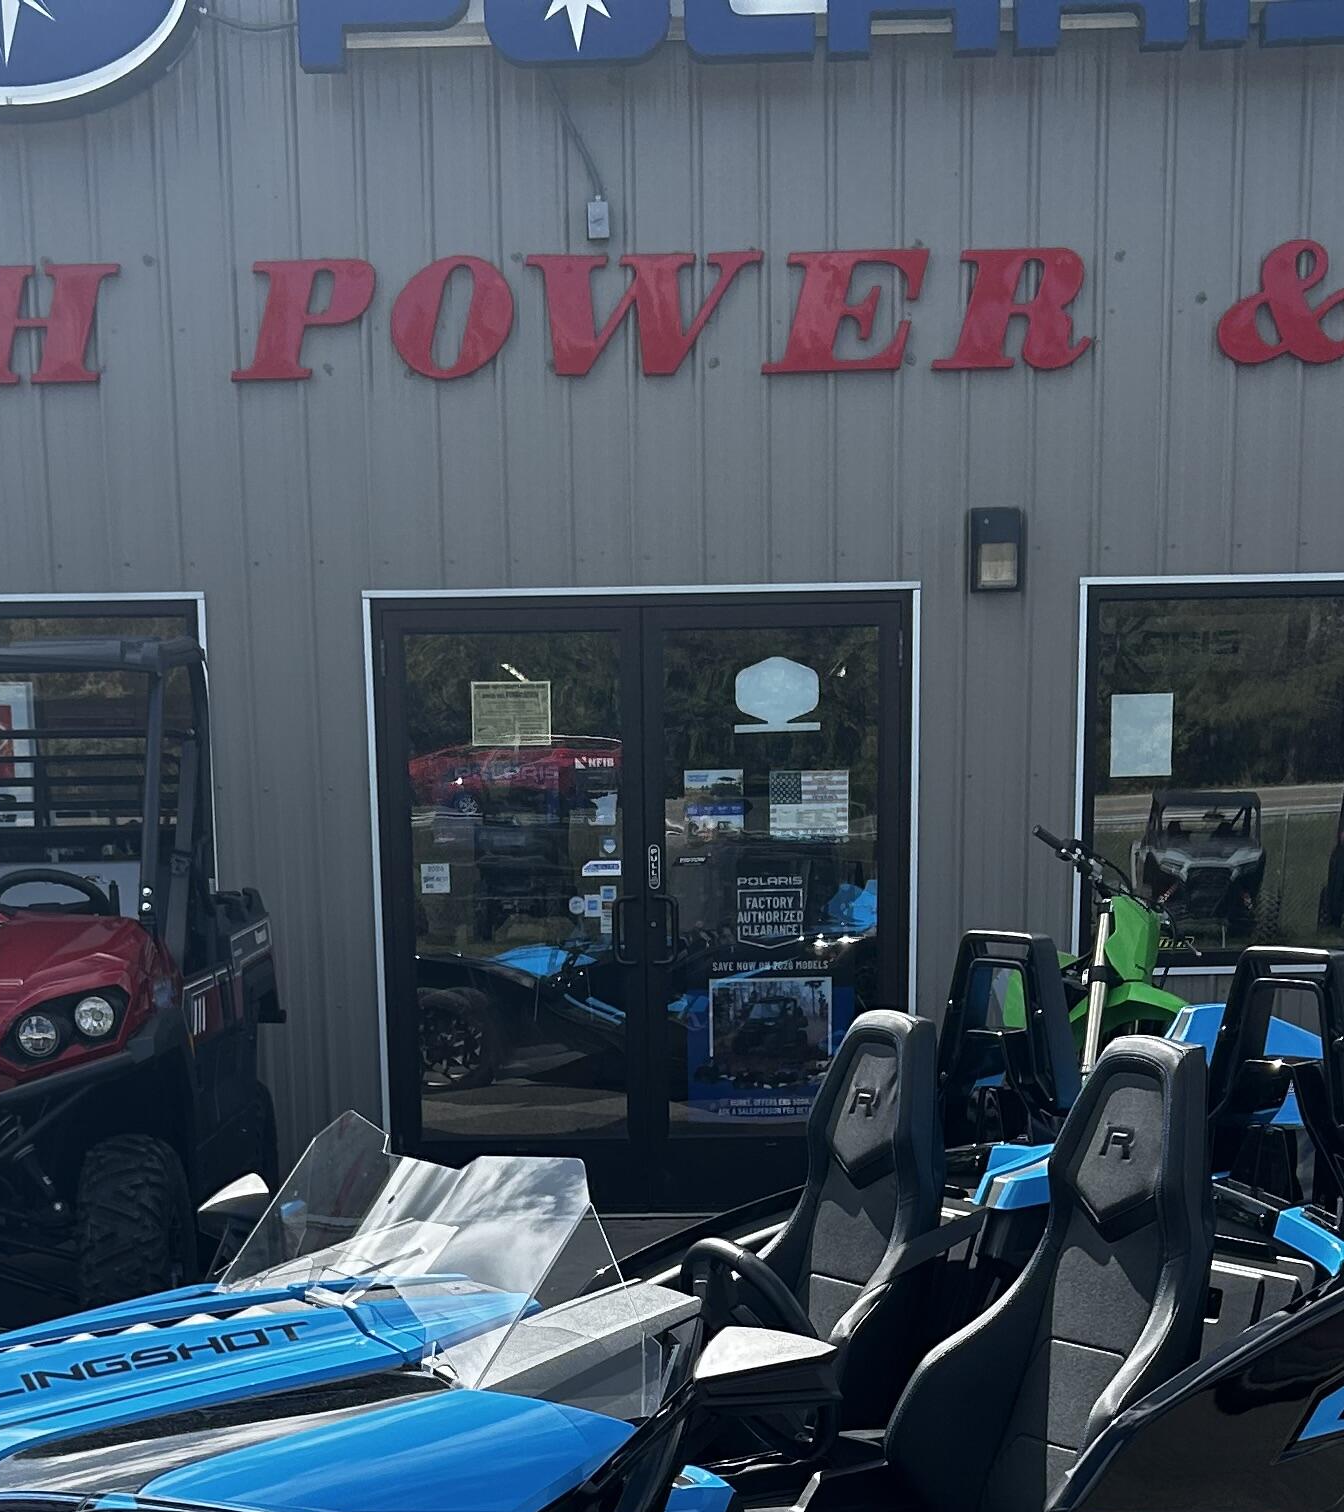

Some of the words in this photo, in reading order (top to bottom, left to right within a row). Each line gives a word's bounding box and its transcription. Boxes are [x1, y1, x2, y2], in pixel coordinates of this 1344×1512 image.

[231, 246, 1092, 383] POWER
[650, 848, 658, 876] PULL
[737, 876, 803, 886] POLARIS
[745, 896, 794, 909] FACTORY
[737, 910, 804, 923] AUTHORIZED
[742, 923, 798, 937] CLEARANCE
[712, 961, 733, 972] SAVE
[736, 961, 755, 971] NOW
[795, 959, 829, 970] MODELS
